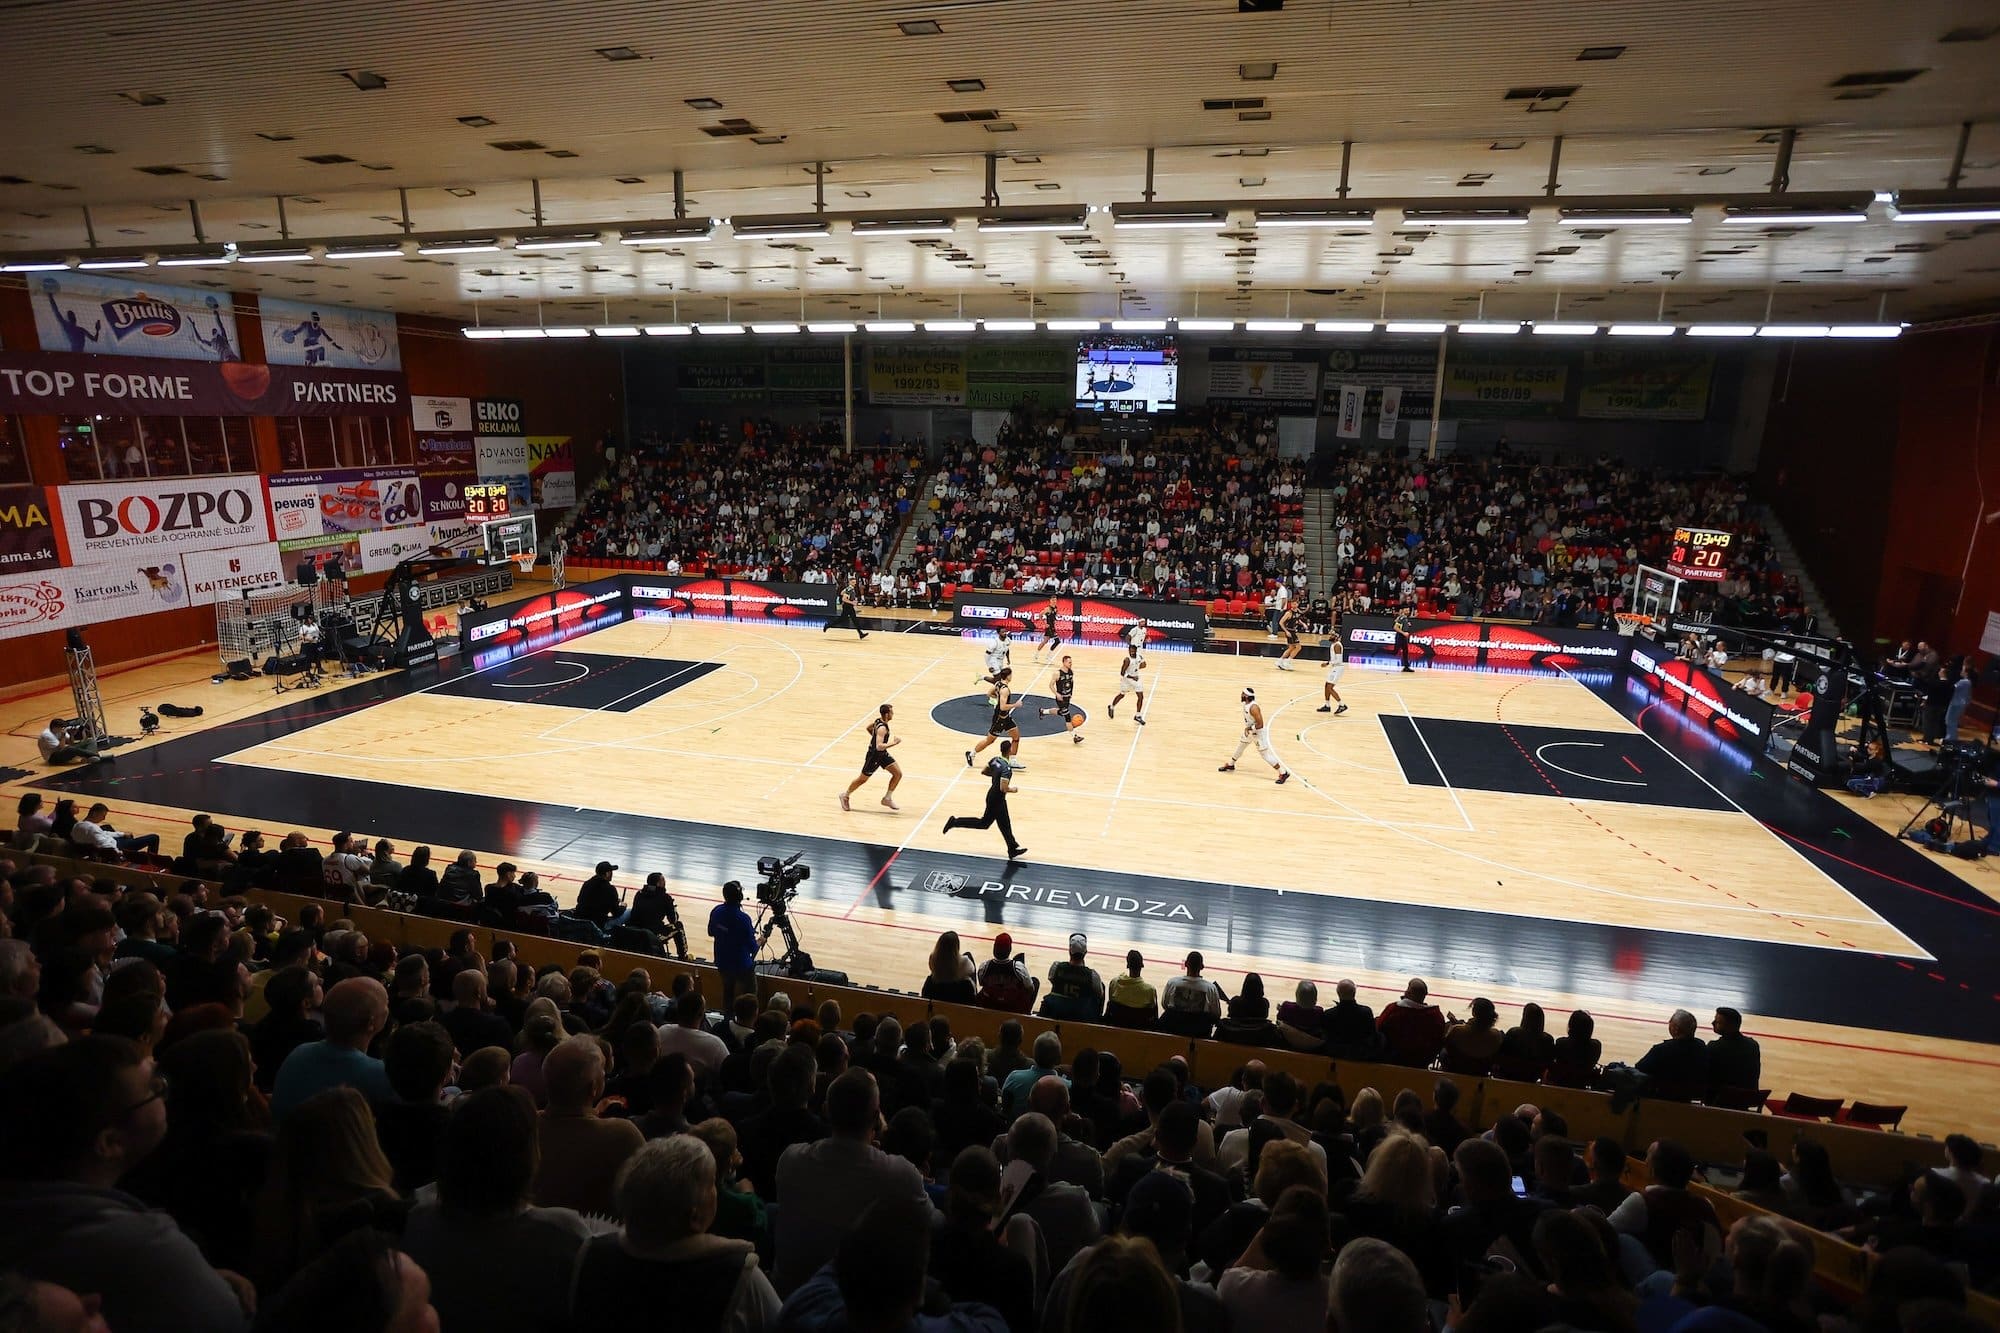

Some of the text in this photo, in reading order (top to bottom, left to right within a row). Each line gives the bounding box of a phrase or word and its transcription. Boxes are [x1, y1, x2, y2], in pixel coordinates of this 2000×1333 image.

[874, 359, 960, 376] Majster ČSFR
[1454, 367, 1508, 384] Majster
[0, 369, 193, 400] TOP FORME
[293, 381, 397, 404] PARTNERS
[894, 378, 940, 390] 1992/93
[477, 401, 520, 422] ERKO
[479, 422, 520, 434] REKLAMA
[275, 498, 314, 511] pewag
[470, 500, 484, 512] 20
[493, 499, 506, 512] 20
[78, 489, 253, 540] BOZPO
[169, 528, 223, 542] OCHRANNÉ
[223, 524, 256, 538] SLUŽBY
[1693, 533, 1731, 547] 03:49
[369, 549, 391, 557] GREMI
[402, 543, 422, 552] KLIMA
[1672, 547, 1722, 567] 20 20
[1685, 569, 1723, 578] PARTNERS
[75, 580, 138, 599] Karton.sk
[643, 588, 670, 598] TIPOS
[674, 590, 691, 600] Hrdý
[786, 596, 828, 607] basketbalu
[973, 608, 1007, 618] TIPOS
[1012, 610, 1033, 621] Hrdý
[1092, 615, 1140, 626] slovenskéh
[1147, 618, 1195, 629] basketbalu
[407, 640, 434, 652] PARTNERS
[1367, 631, 1396, 643] TIPO
[1409, 635, 1432, 647] Hrdý
[1501, 640, 1561, 653] slovenského
[1563, 644, 1618, 657] basketbalu
[1795, 743, 1820, 763] PARTNERS
[979, 881, 1194, 920] PRIEVIDZA
